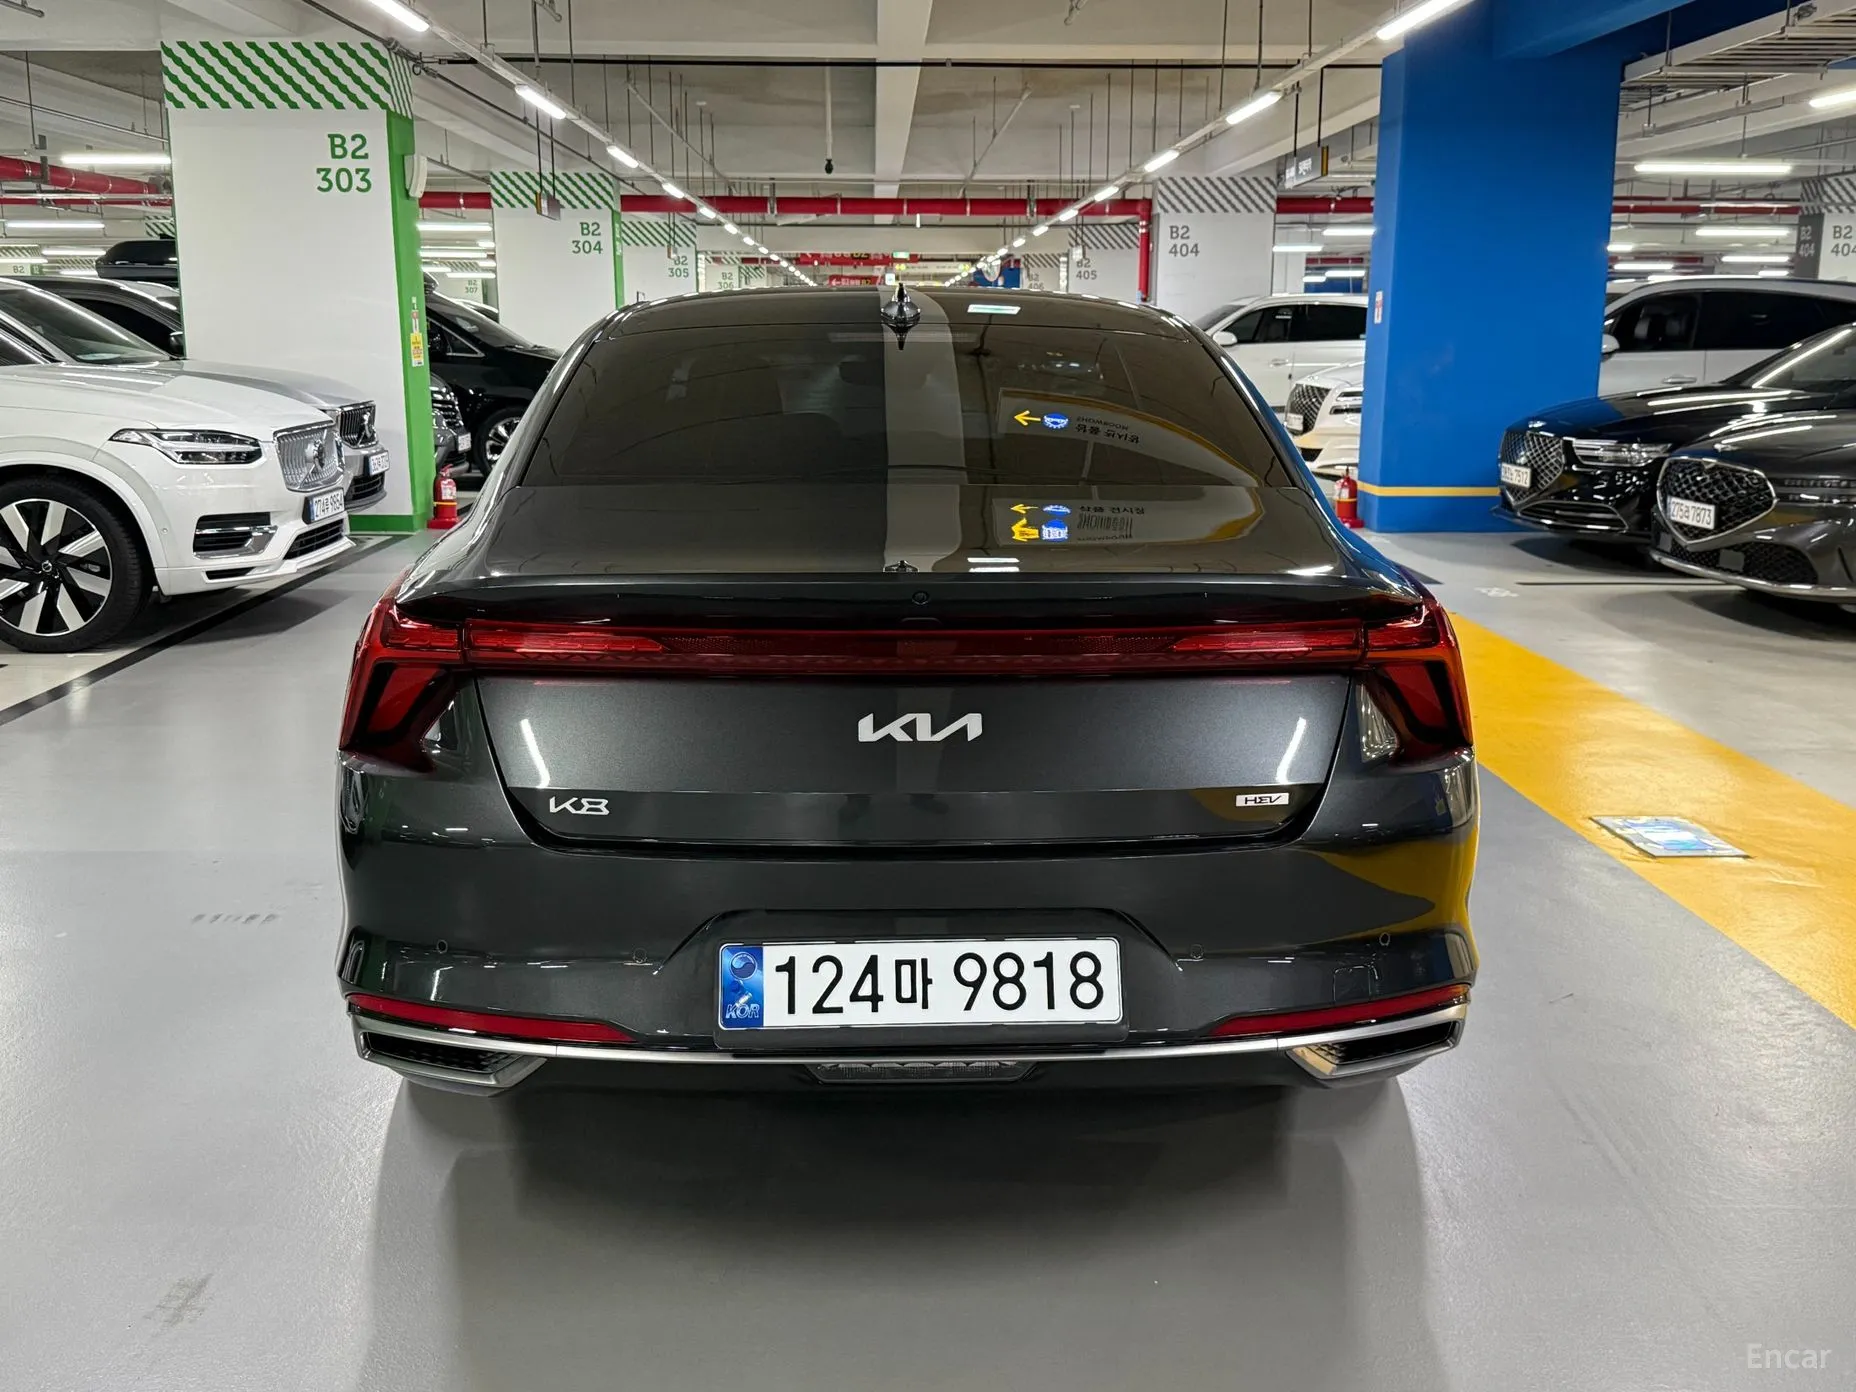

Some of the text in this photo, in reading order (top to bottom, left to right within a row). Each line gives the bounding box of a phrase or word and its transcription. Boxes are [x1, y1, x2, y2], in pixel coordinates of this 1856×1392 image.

[327, 133, 369, 159] B2
[316, 167, 372, 193] 303
[579, 221, 601, 236] B2
[1168, 224, 1190, 240] B2
[1832, 224, 1853, 239] B2
[571, 240, 603, 254] 304
[1168, 243, 1200, 257] 404
[674, 255, 688, 266] B2
[1076, 258, 1091, 268] B2
[668, 267, 689, 278] 305
[721, 271, 733, 281] B2
[1076, 270, 1097, 280] 405
[717, 281, 735, 290] 306
[1691, 505, 1712, 525] 7873
[858, 713, 982, 743] KIA
[549, 796, 610, 815] K8
[1245, 795, 1282, 804] HEV
[775, 951, 1104, 1015] 124마 9818
[725, 1003, 760, 1019] KOR
